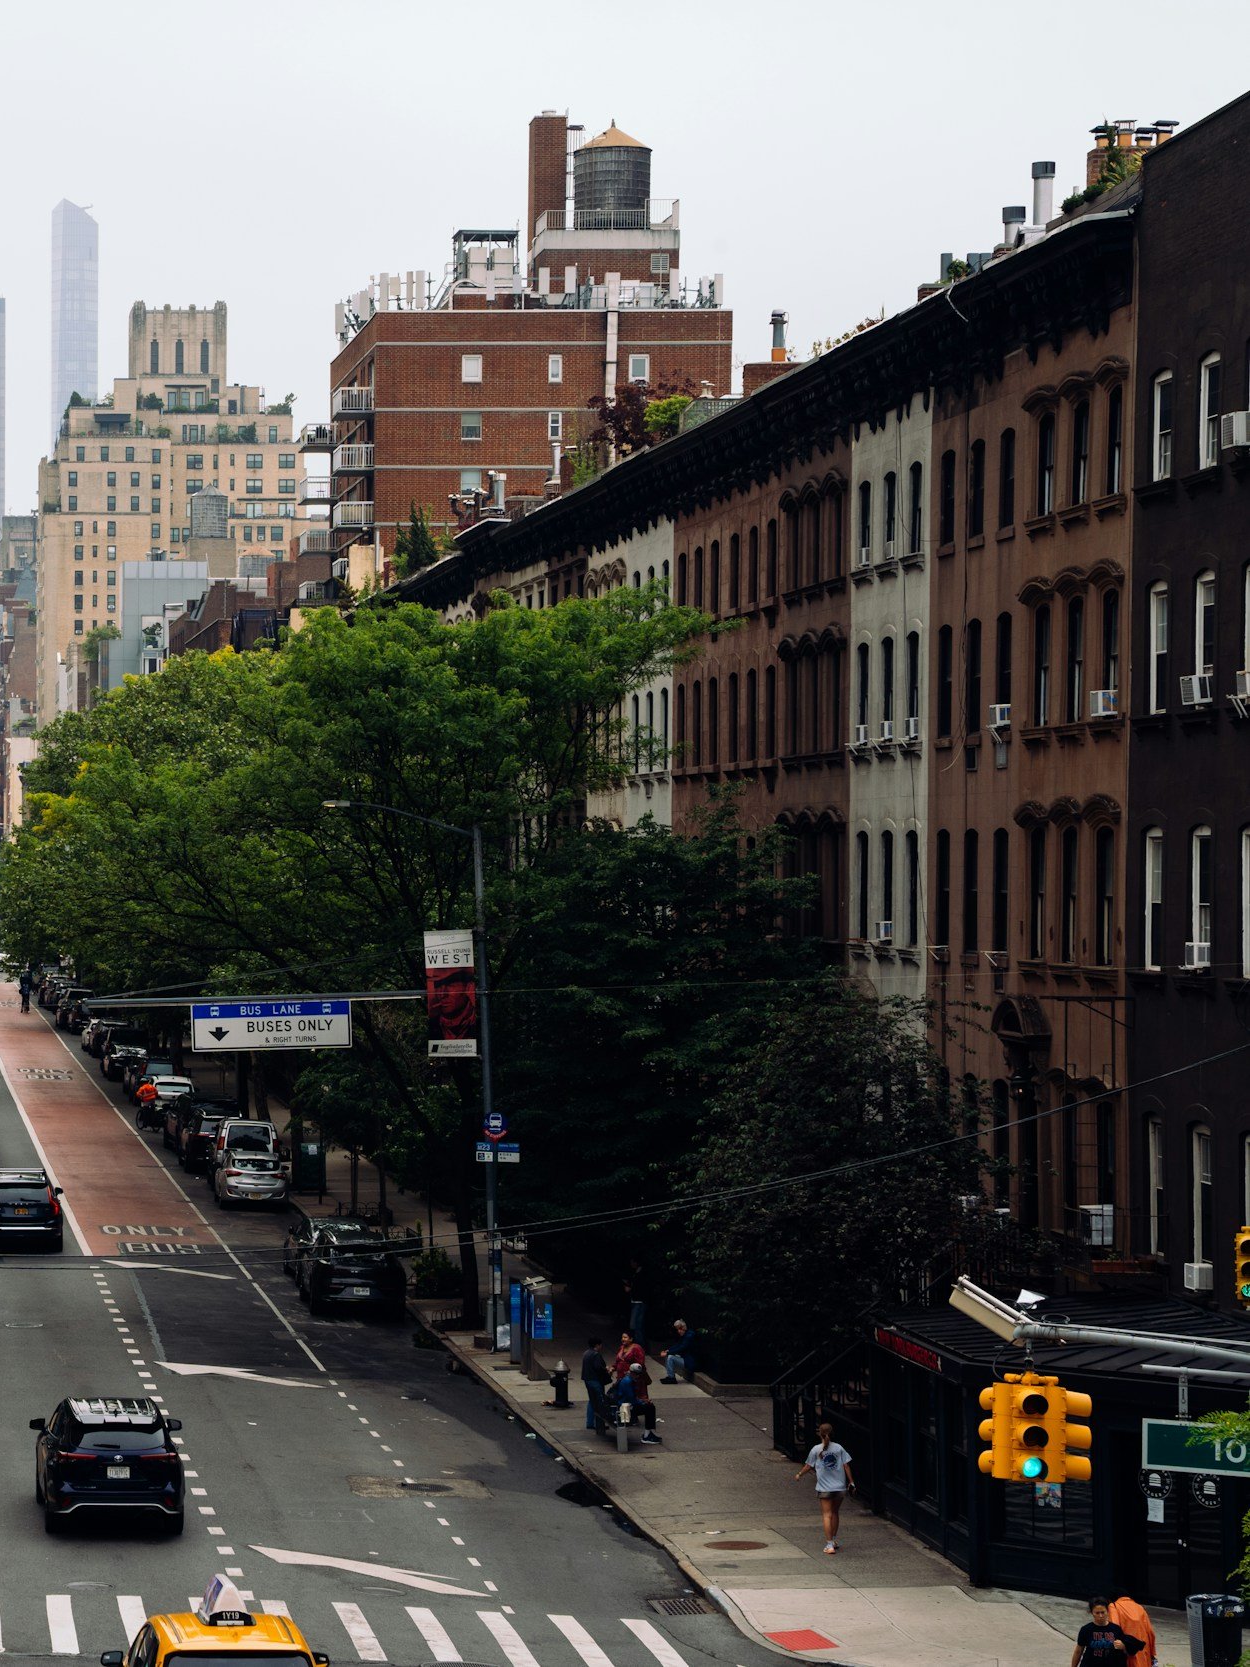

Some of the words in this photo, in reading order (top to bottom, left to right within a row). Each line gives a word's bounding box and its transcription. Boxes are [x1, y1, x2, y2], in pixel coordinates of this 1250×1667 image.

[427, 953, 471, 965] WEST
[240, 1005, 262, 1016] BUS
[272, 1004, 302, 1015] LANE
[247, 1020, 292, 1033] BUSES
[297, 1019, 333, 1032] ONLY
[295, 1035, 317, 1043] TURNS
[102, 1225, 184, 1236] ONLY
[124, 1242, 201, 1255] BUS
[1214, 1438, 1247, 1464] 10
[221, 1611, 240, 1620] 1Y19
